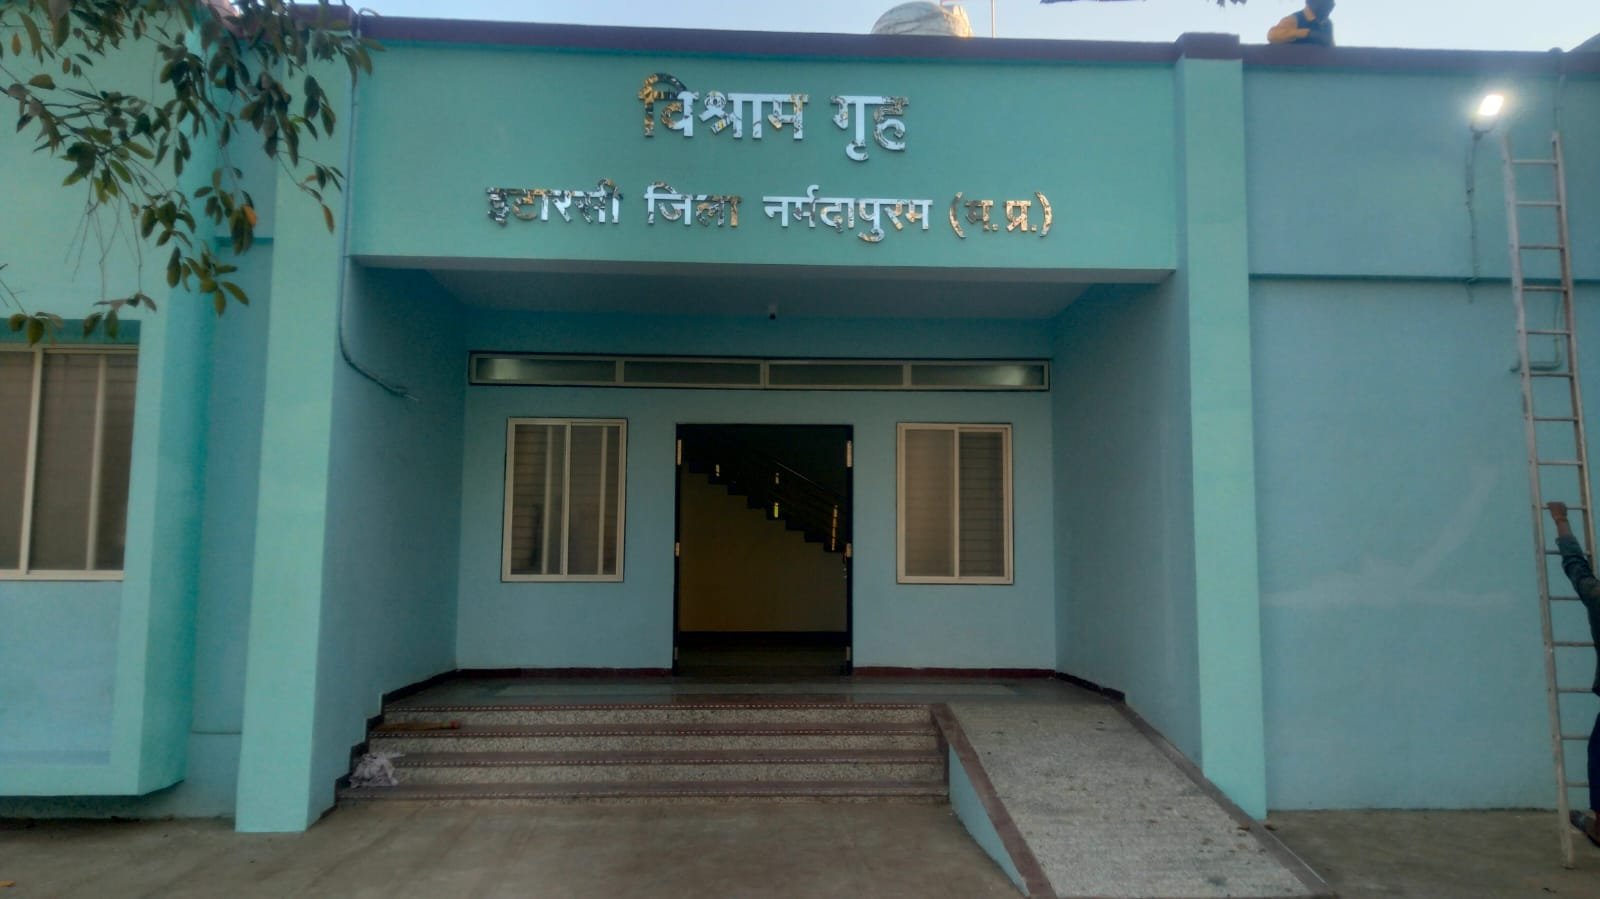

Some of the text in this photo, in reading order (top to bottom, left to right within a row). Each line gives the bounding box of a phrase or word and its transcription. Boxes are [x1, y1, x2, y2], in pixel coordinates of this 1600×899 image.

[638, 72, 909, 161] विश्राम गृह
[486, 178, 624, 226] इटारसी
[644, 180, 742, 227] जिला
[762, 184, 933, 243] नर्मदापुरम
